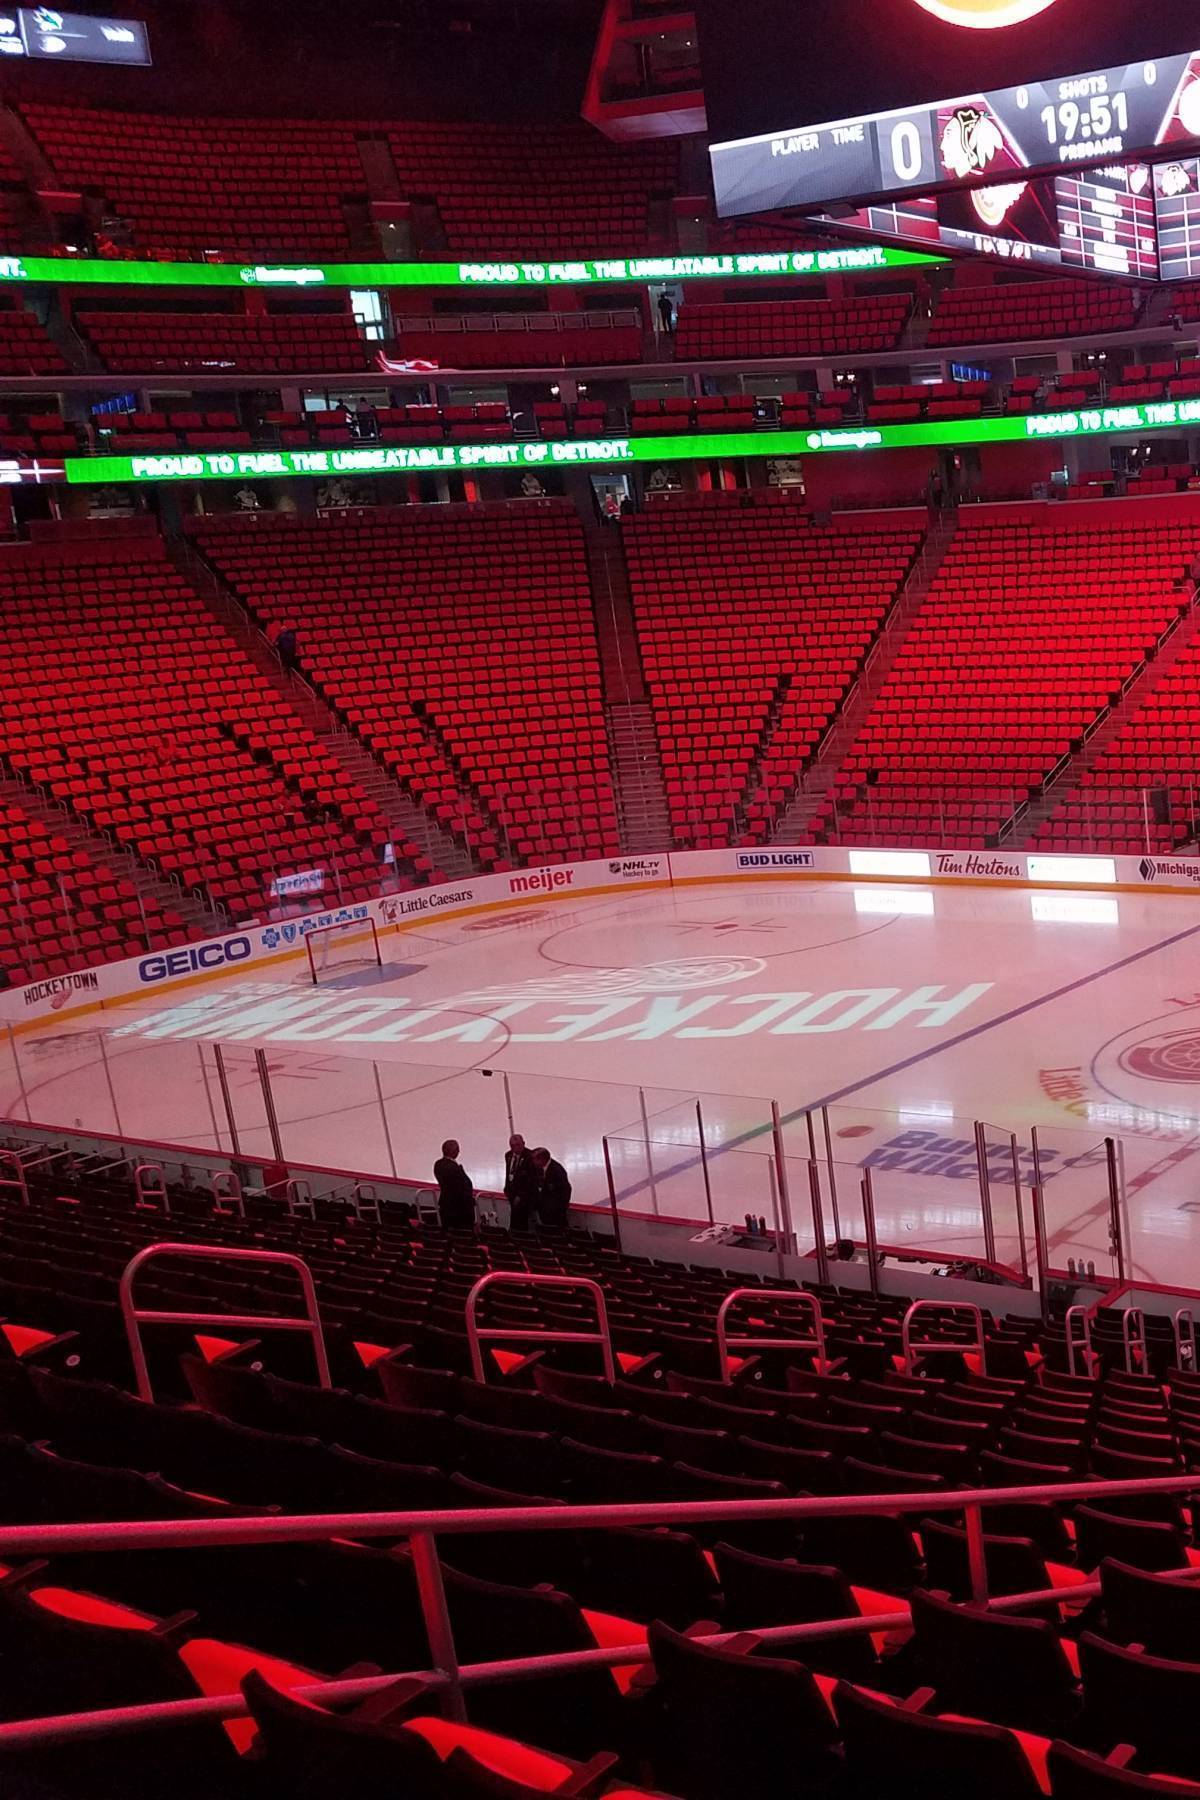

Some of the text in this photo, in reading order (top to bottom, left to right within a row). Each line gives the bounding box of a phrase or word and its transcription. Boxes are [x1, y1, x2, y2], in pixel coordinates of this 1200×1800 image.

[1058, 76, 1108, 99] SHOTS
[1143, 62, 1157, 84] 0
[1016, 88, 1029, 109] 0
[1040, 92, 1128, 143] 19:51
[771, 125, 865, 157] PLAYER TIME
[891, 121, 922, 180] 0
[1059, 137, 1123, 161] PREGAME
[459, 263, 518, 282] PROUD
[522, 263, 545, 281] TO
[549, 262, 590, 280] FUEL
[594, 260, 627, 278] THE
[630, 256, 734, 277] UNBEATABLE
[737, 253, 788, 273] SPIRIT
[793, 252, 814, 270] OF
[1027, 411, 1079, 435] PROUD
[1080, 410, 1102, 431] TO
[1103, 406, 1144, 430] FUEL
[1147, 402, 1177, 425] THE
[132, 440, 635, 477] PROUD TO FUEL THE UNBEATABLE SPIRIT OF DETROIT.
[622, 860, 660, 871] NHL.TV
[738, 853, 811, 867] BUD LIGHT
[936, 854, 963, 874] Tim
[509, 868, 574, 893] meijer
[400, 889, 474, 915] Little Caesars
[138, 936, 251, 983] GEICO
[23, 971, 99, 1006] HOCKEYTOWN
[882, 1130, 1061, 1164] Burns
[858, 1148, 1058, 1187] Wilcox
